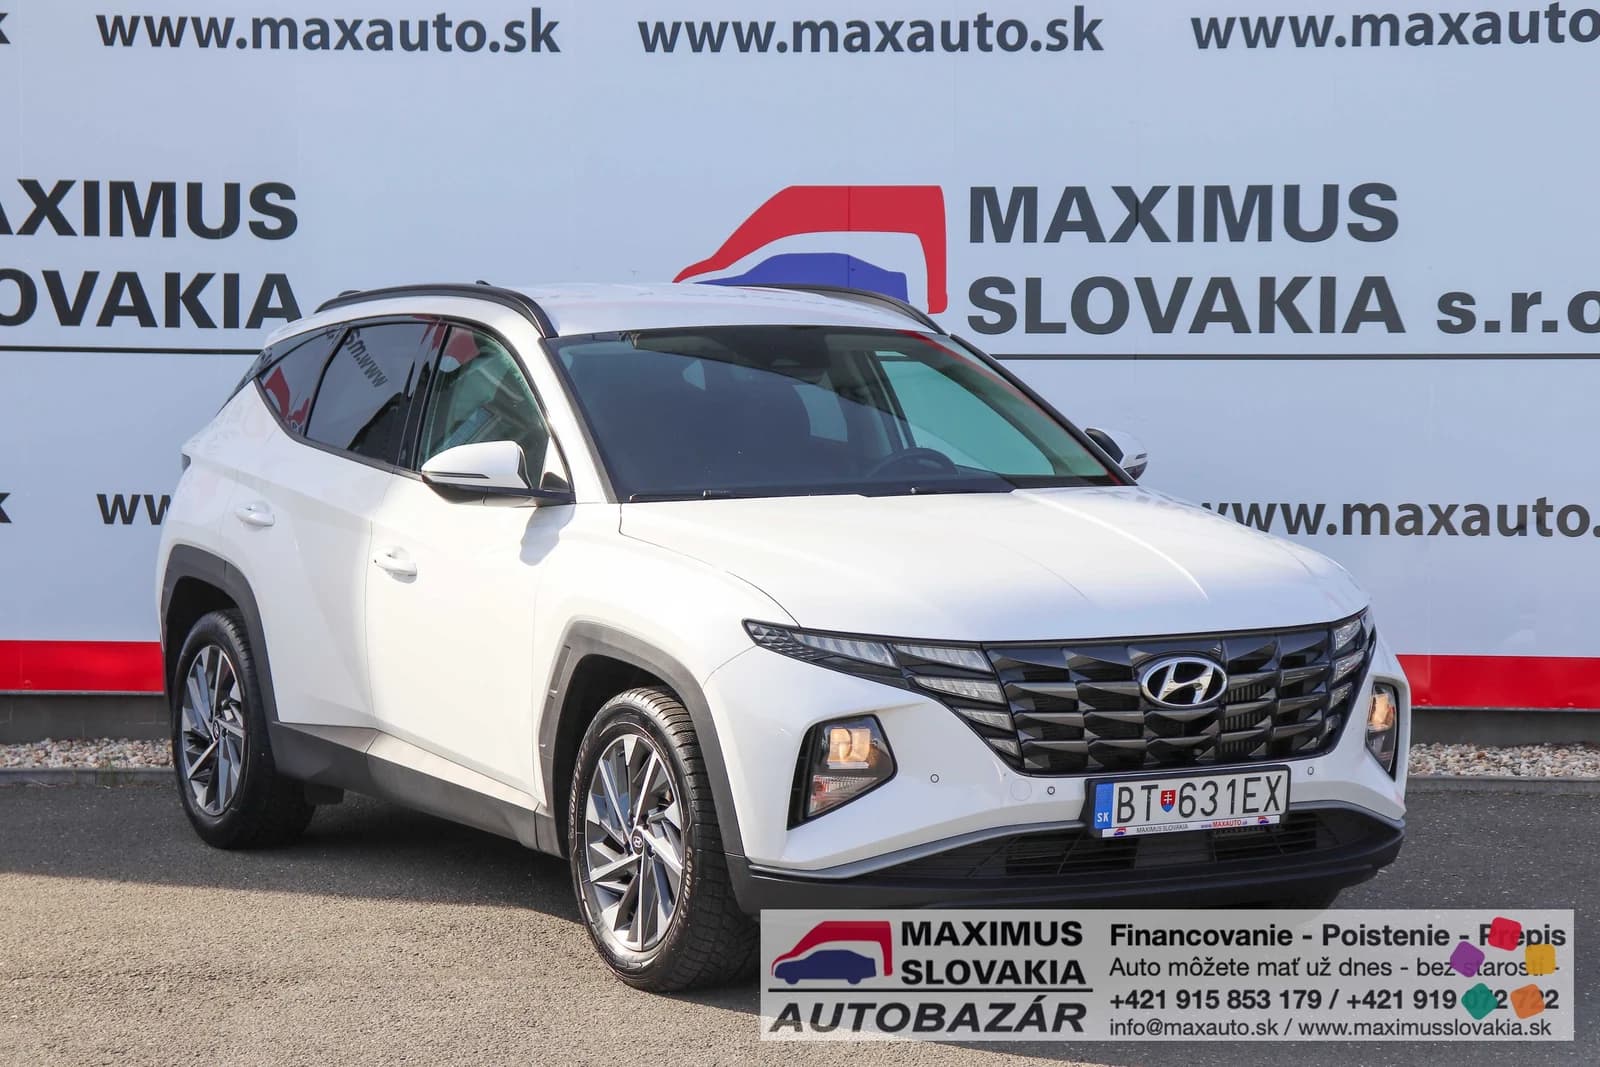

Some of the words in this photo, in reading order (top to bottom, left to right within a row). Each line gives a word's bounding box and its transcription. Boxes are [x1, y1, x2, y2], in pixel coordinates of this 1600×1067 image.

[96, 8, 561, 53] www.maxauto.sk
[638, 5, 1104, 53] www.maxauto.sk
[1191, 1, 1600, 49] www.maxauto
[0, 179, 298, 240] XIMUS
[969, 182, 1399, 243] MAXIMUS
[967, 275, 1406, 335] SLOVAKIA
[1436, 290, 1600, 334] s.r.o
[1097, 812, 1109, 823] SK
[1117, 784, 1159, 824] BT
[1178, 775, 1282, 819] 631EX
